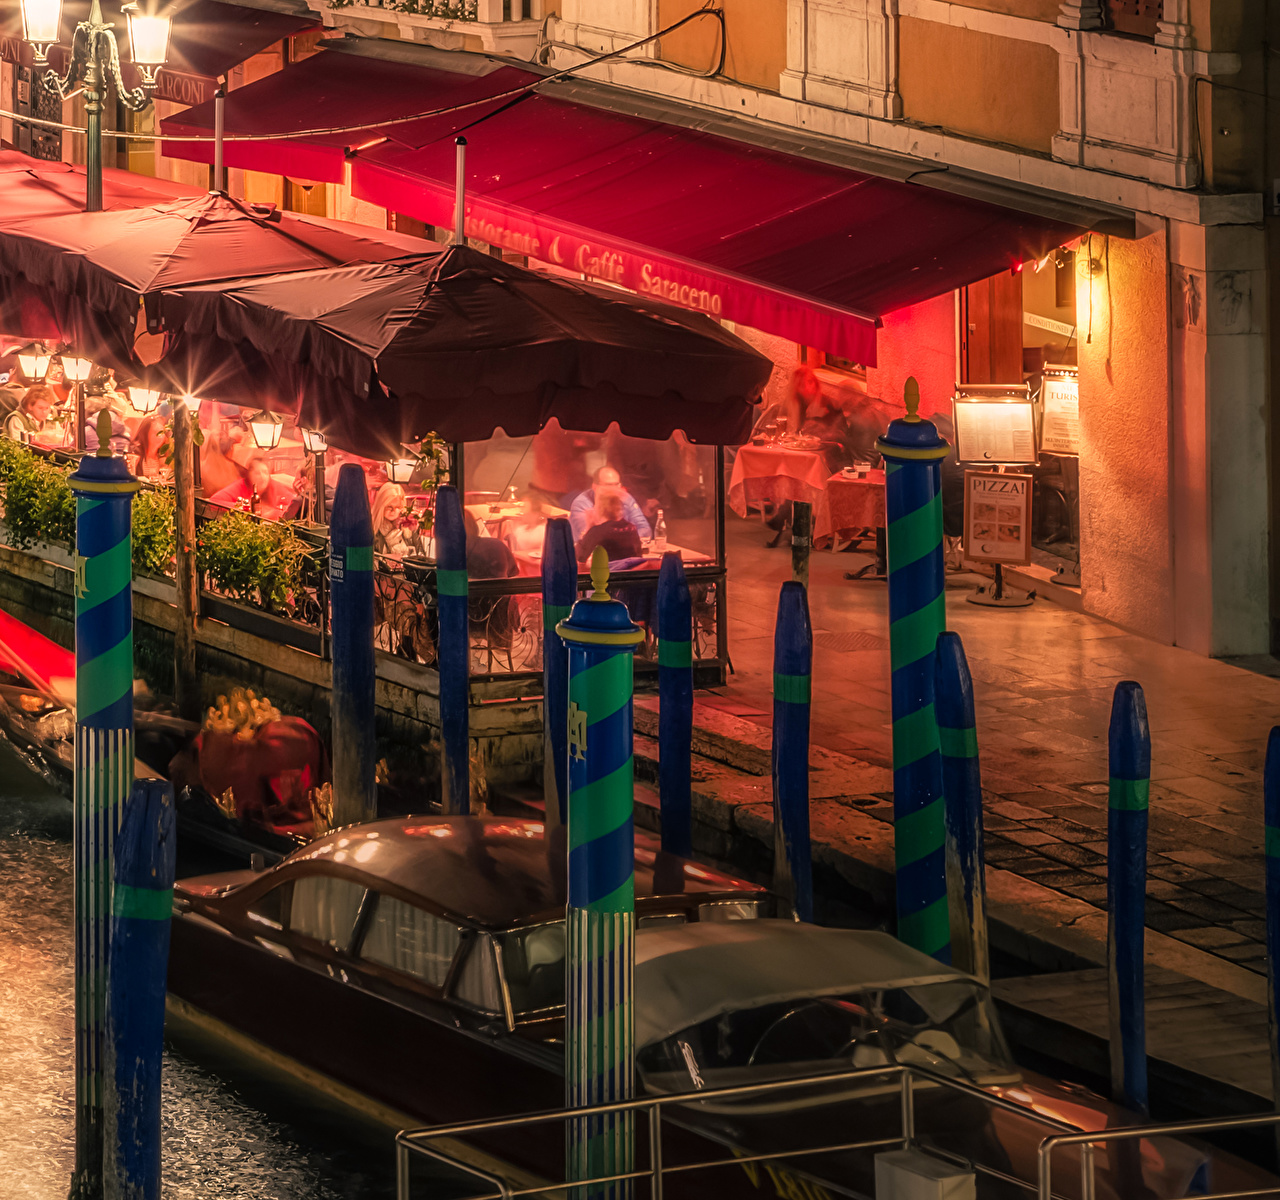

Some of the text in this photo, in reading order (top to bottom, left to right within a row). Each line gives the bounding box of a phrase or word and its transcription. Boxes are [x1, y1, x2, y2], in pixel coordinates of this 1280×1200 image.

[151, 72, 205, 102] ARCONI
[451, 203, 722, 315] istorante Caffè Saraceno
[1028, 315, 1069, 334] CONDITIONED
[973, 479, 1025, 495] PIZZA!
